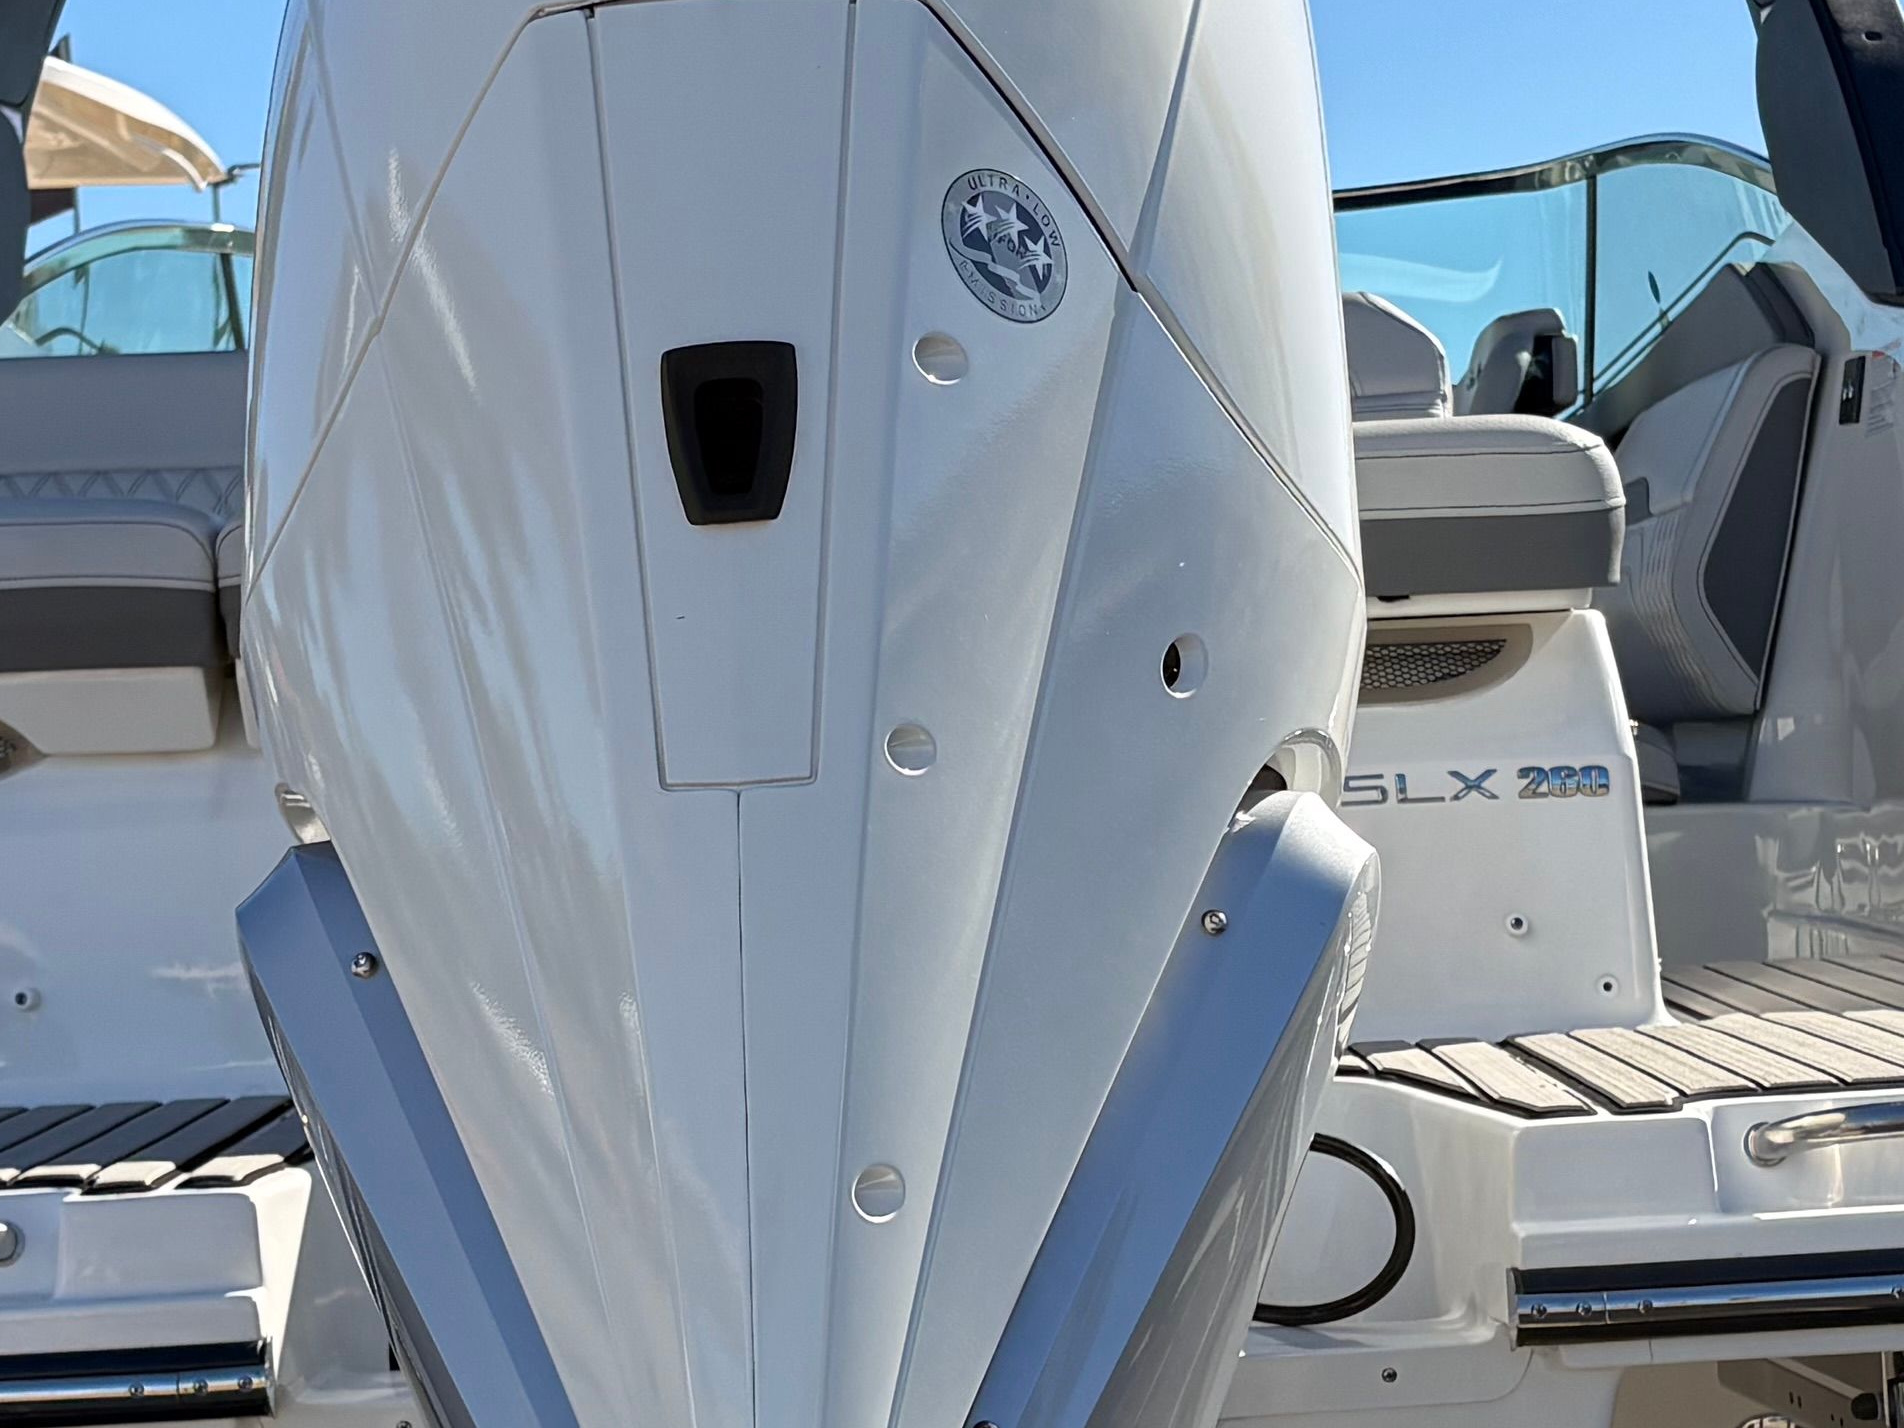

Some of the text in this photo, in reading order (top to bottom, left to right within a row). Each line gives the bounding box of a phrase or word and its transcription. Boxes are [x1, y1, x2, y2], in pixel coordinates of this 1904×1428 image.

[967, 174, 1020, 198] ULTRA
[1032, 203, 1061, 248] LOW
[1341, 769, 1499, 807] SLX
